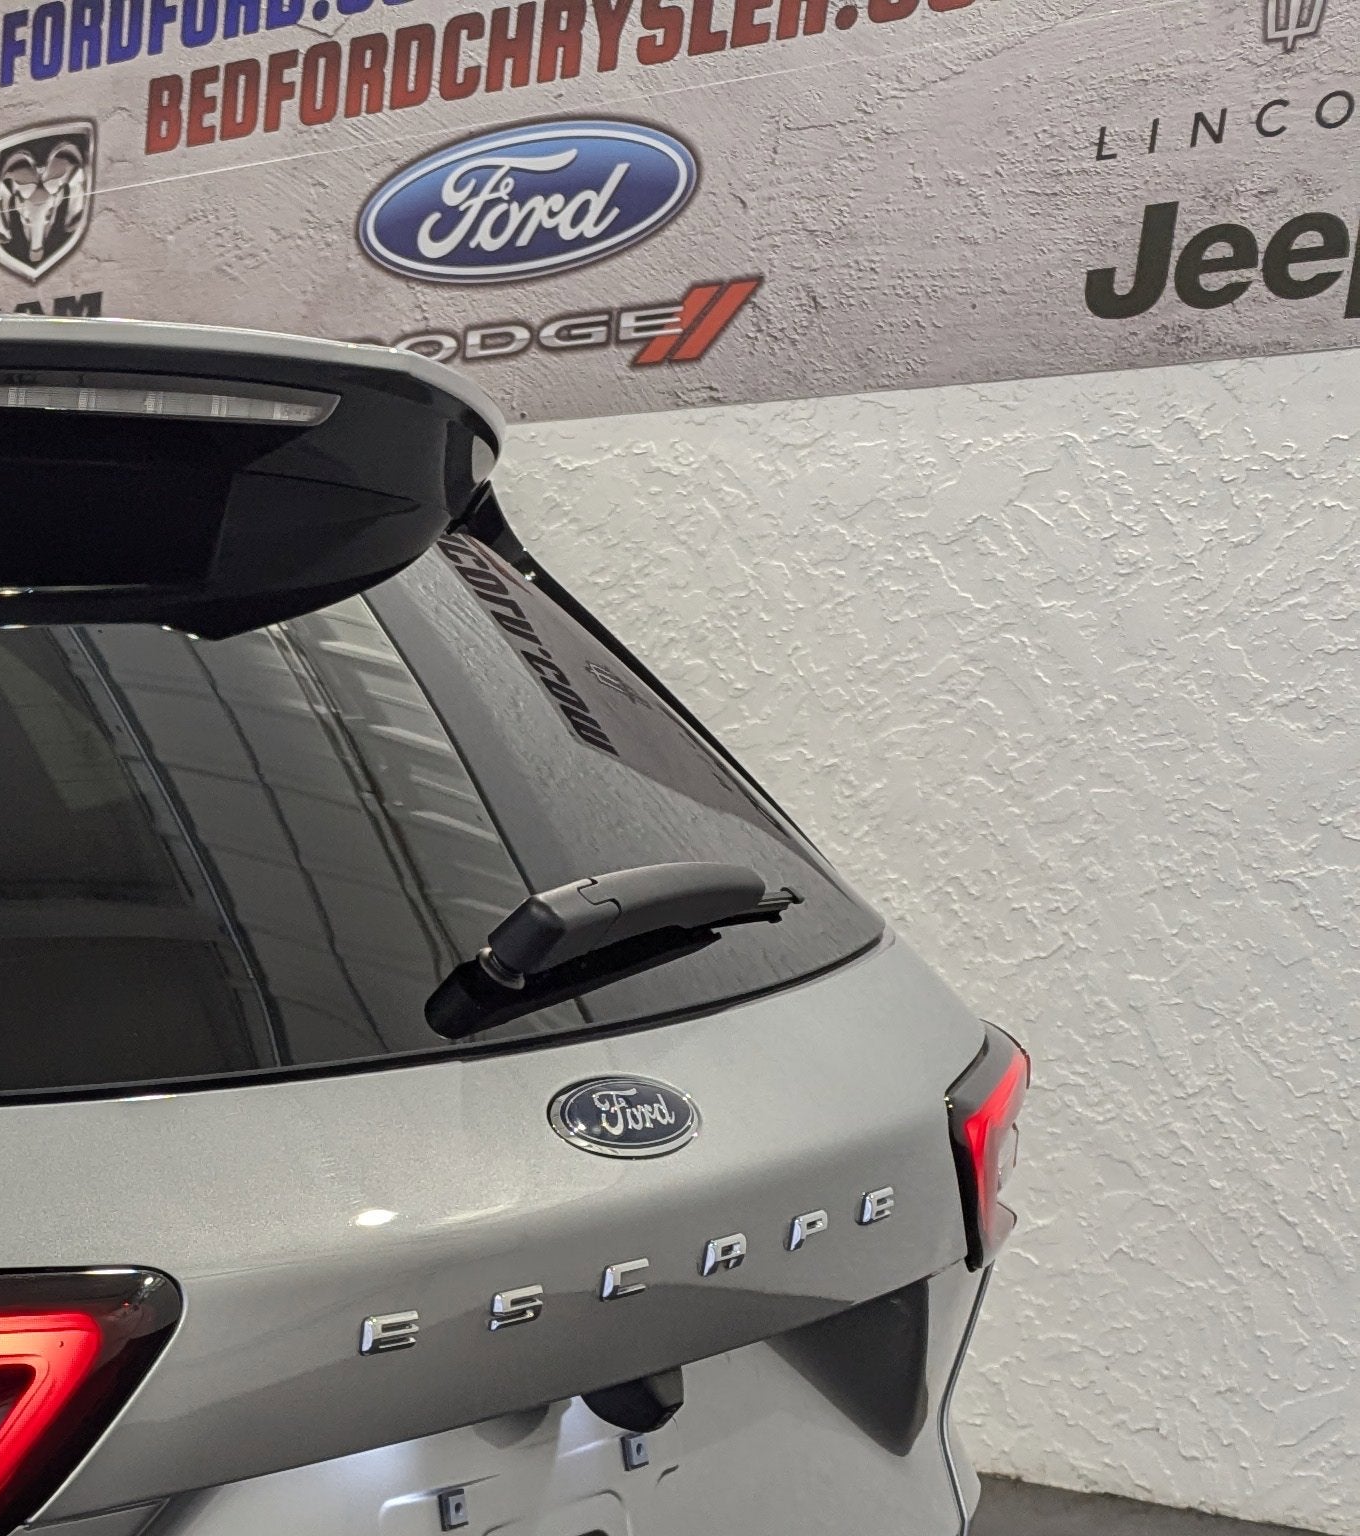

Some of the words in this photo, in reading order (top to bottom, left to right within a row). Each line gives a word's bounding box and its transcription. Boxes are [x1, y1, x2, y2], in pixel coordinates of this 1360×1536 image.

[145, 0, 977, 155] BEDFORDCHRYSLE.
[1096, 90, 1355, 161] LINCO
[417, 148, 631, 259] Ford
[1085, 201, 1360, 319] Jee
[394, 304, 685, 362] ODGE
[593, 1087, 676, 1136] Ford
[358, 1185, 895, 1356] ESCAPE
